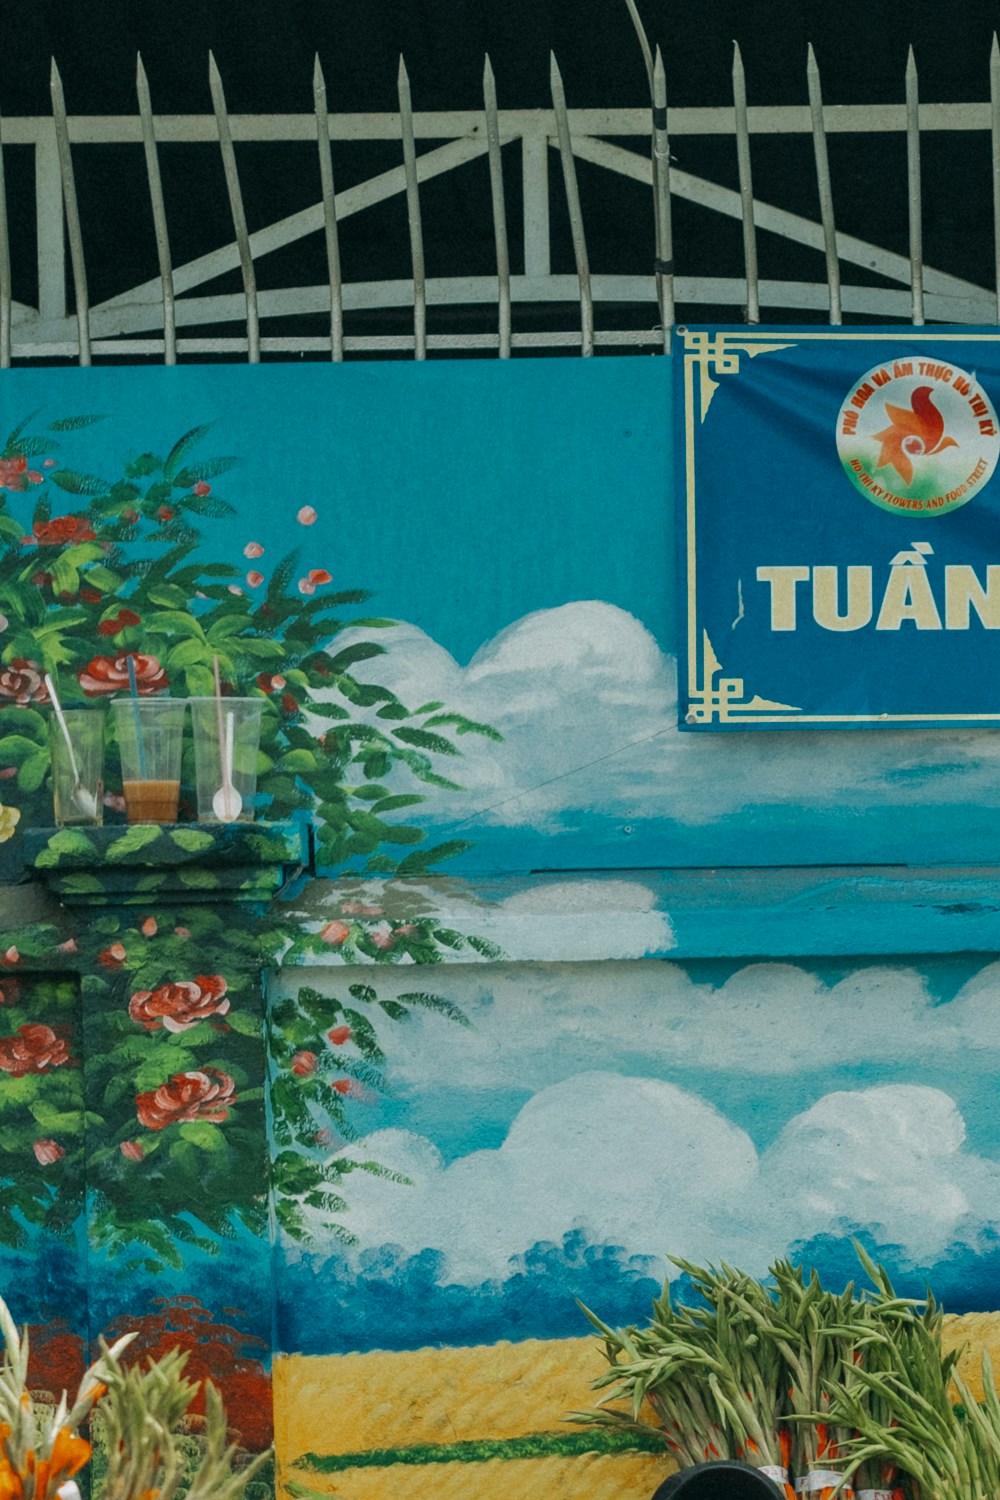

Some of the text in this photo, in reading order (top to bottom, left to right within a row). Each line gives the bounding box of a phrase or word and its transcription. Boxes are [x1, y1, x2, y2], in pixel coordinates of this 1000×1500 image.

[851, 383, 875, 408] HOA
[858, 472, 874, 488] THI
[870, 484, 885, 497] KY
[883, 493, 924, 510] FLOWERS
[926, 496, 944, 510] AND
[945, 485, 968, 503] FOOD
[966, 457, 988, 487] STREET
